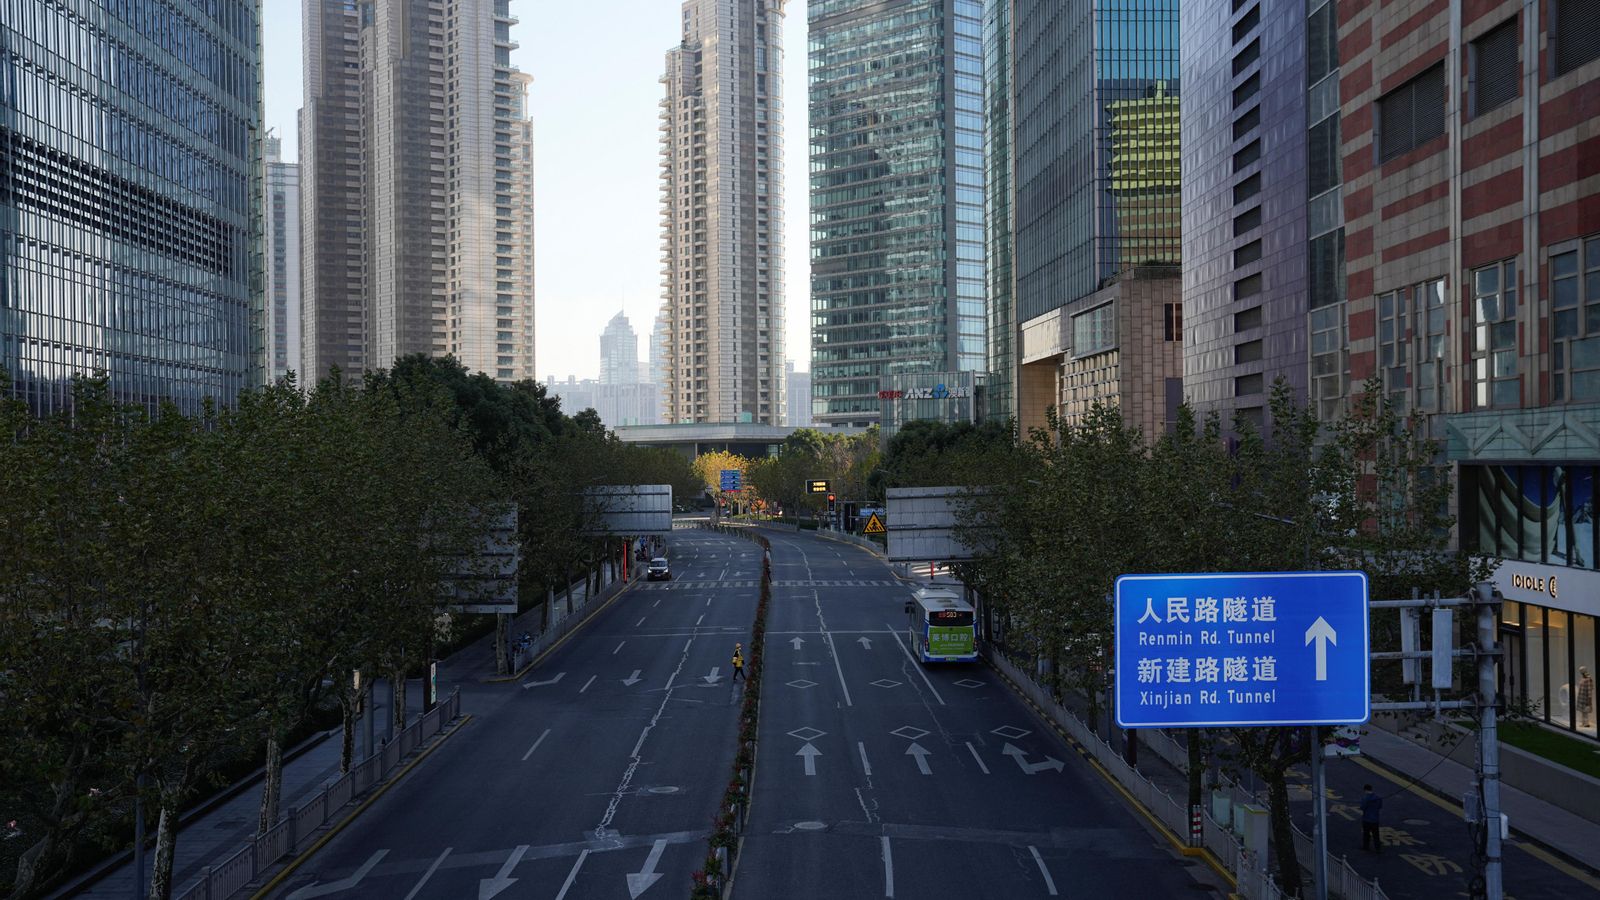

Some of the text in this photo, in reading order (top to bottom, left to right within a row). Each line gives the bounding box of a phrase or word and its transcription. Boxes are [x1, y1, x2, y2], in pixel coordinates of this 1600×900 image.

[905, 388, 933, 399] ANZ
[1512, 574, 1544, 593] ICICLE
[1137, 597, 1277, 624] 人民路隧道
[1139, 629, 1276, 645] Renmin Rd. Tunnel
[1137, 657, 1277, 684] 新建路隧道
[1140, 689, 1276, 709] Xinjian Rd. Tunnel
